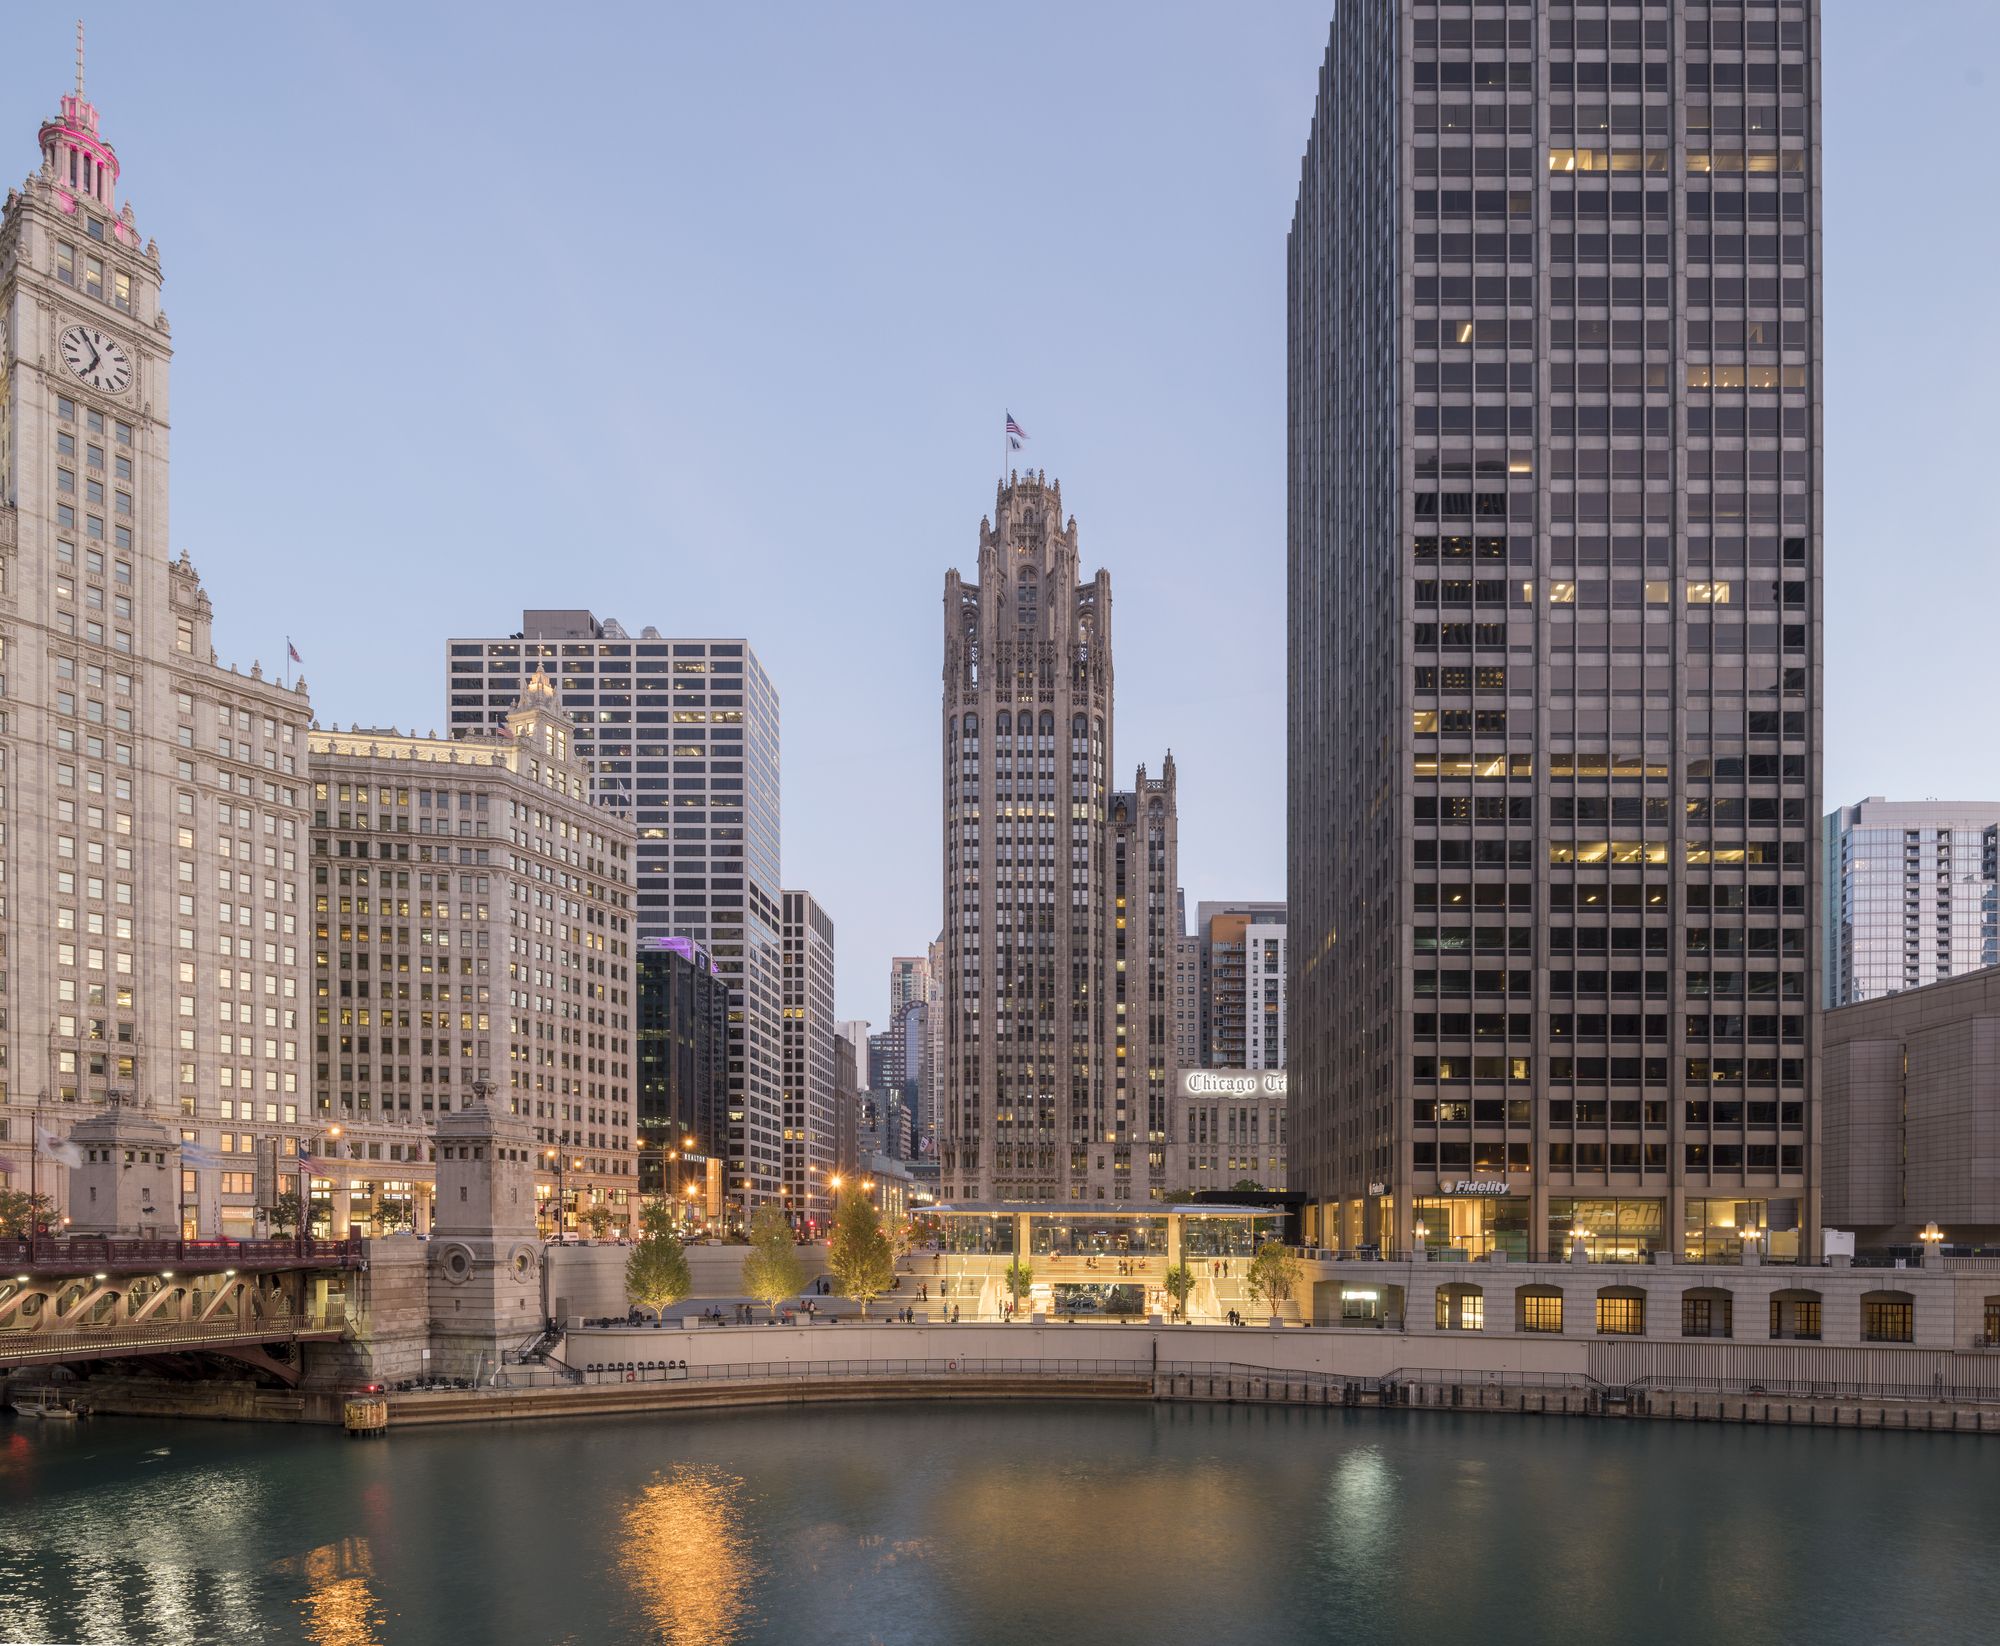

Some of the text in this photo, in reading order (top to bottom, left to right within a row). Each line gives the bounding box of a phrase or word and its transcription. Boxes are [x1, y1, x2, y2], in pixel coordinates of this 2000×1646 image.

[1188, 1073, 1255, 1093] Chicago
[684, 1153, 705, 1163] REALTOR
[1455, 1180, 1510, 1194] Fidelity
